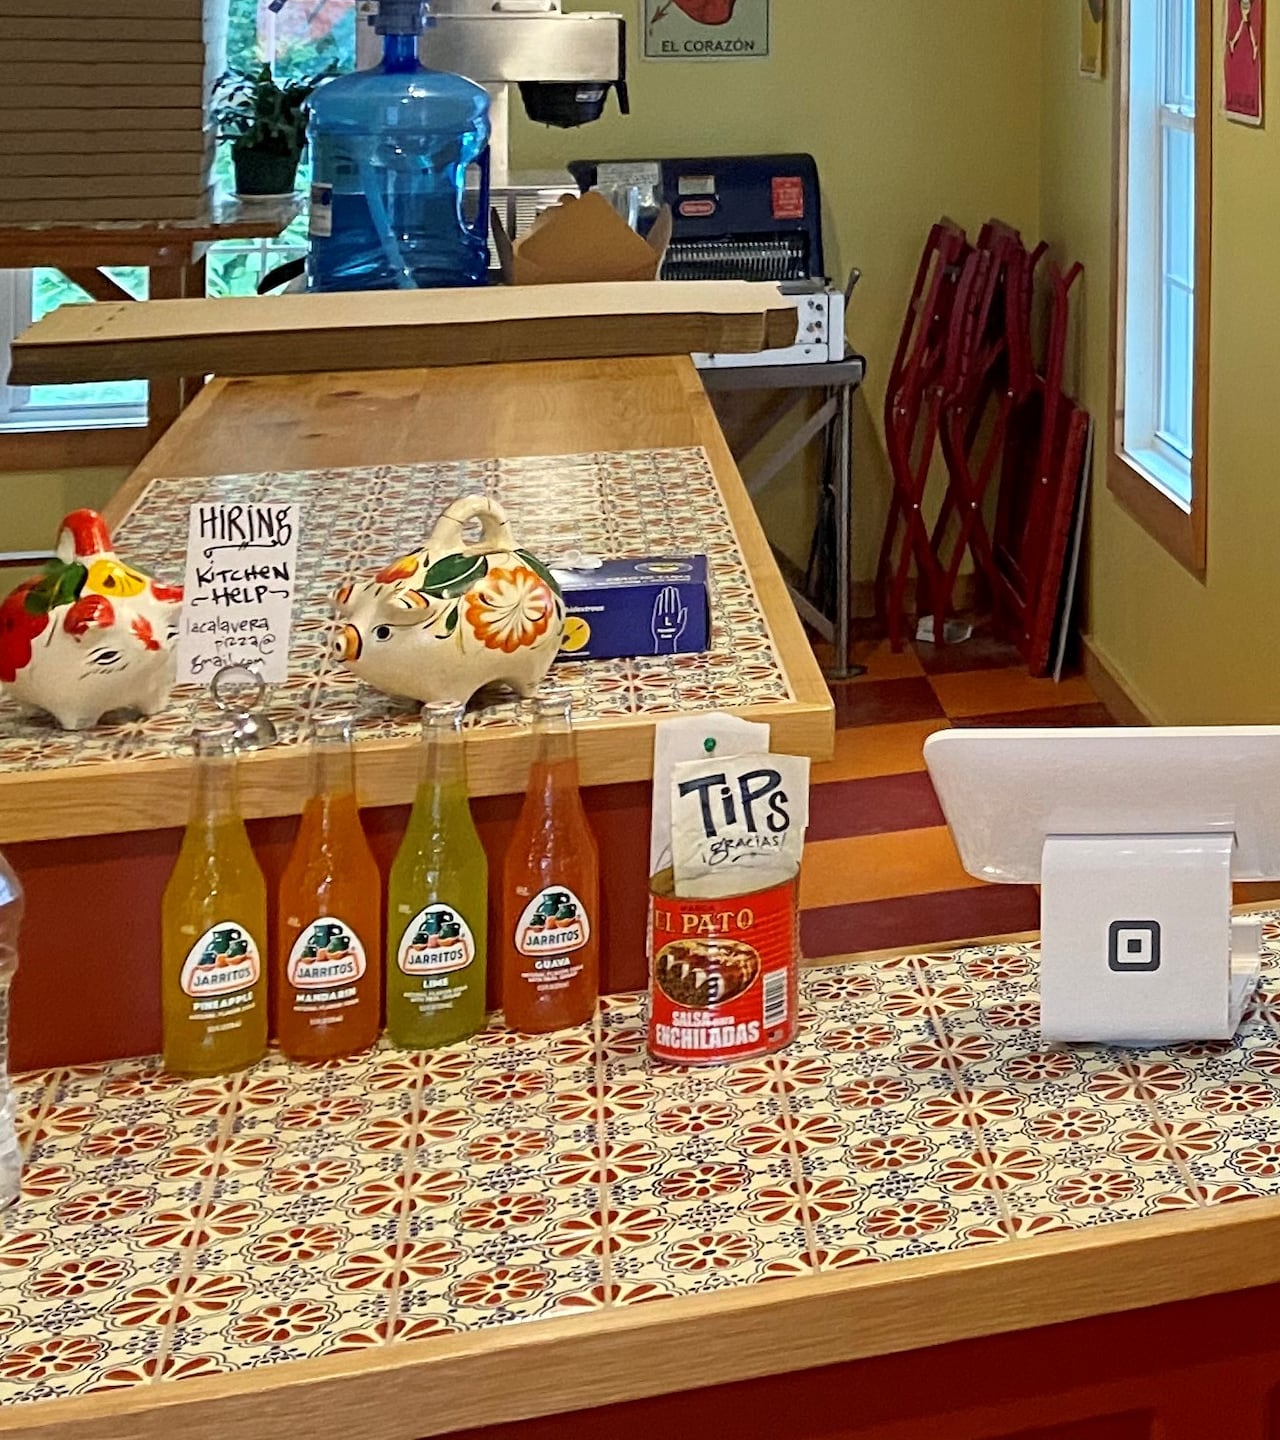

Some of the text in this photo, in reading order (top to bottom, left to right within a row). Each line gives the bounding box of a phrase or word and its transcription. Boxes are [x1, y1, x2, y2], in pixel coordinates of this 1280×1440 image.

[661, 37, 755, 53] EL CORAZÓN
[655, 908, 754, 935] EL PATO
[526, 929, 579, 947] JARRITOS
[408, 948, 463, 965] JARRITOS
[534, 957, 571, 970] GUAVA
[193, 967, 251, 987] JARRITOS
[296, 961, 354, 980] JARRITOS
[422, 977, 449, 989] LIME
[192, 991, 254, 1011] PINEAPPLE
[295, 987, 357, 1003] MANDARIN
[672, 1011, 711, 1026] SALSA
[655, 1021, 760, 1050] ENCHILADAS
